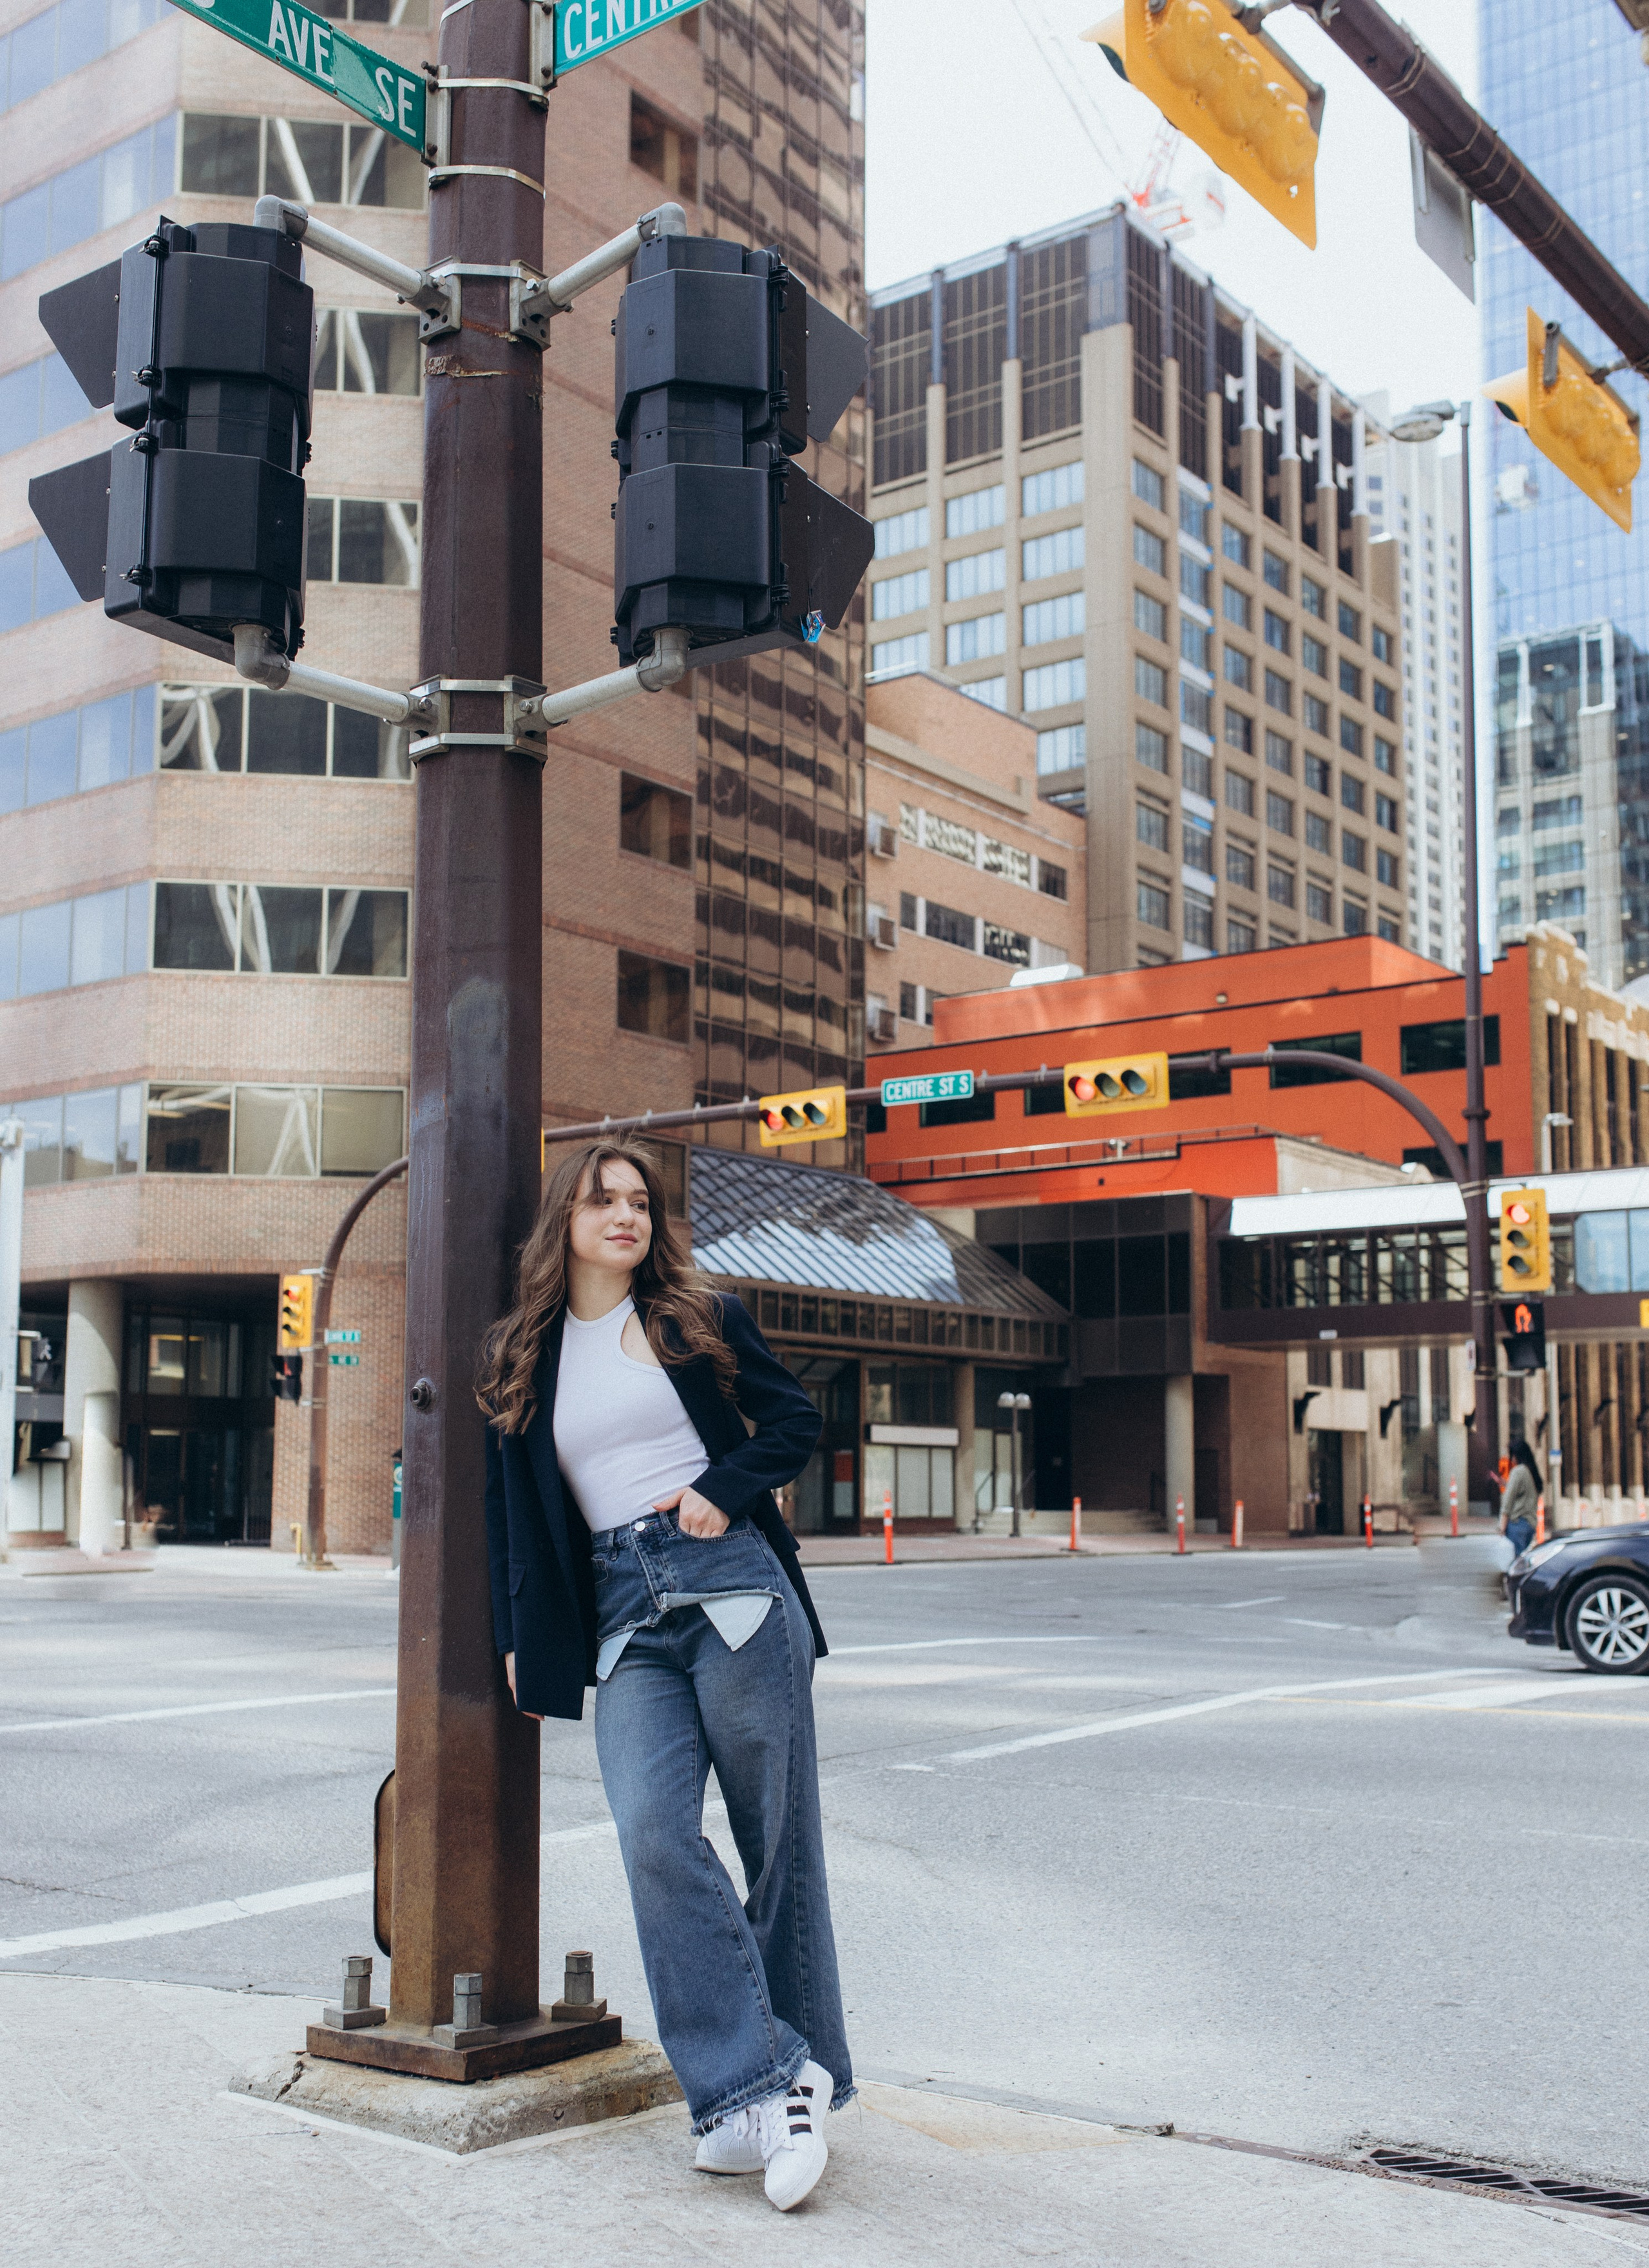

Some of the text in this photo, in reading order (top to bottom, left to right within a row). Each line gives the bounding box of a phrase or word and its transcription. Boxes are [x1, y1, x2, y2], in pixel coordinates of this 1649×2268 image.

[564, 0, 687, 59] CEN
[268, 0, 416, 137] AVE SE
[886, 1075, 969, 1100] CENTRE ST S
